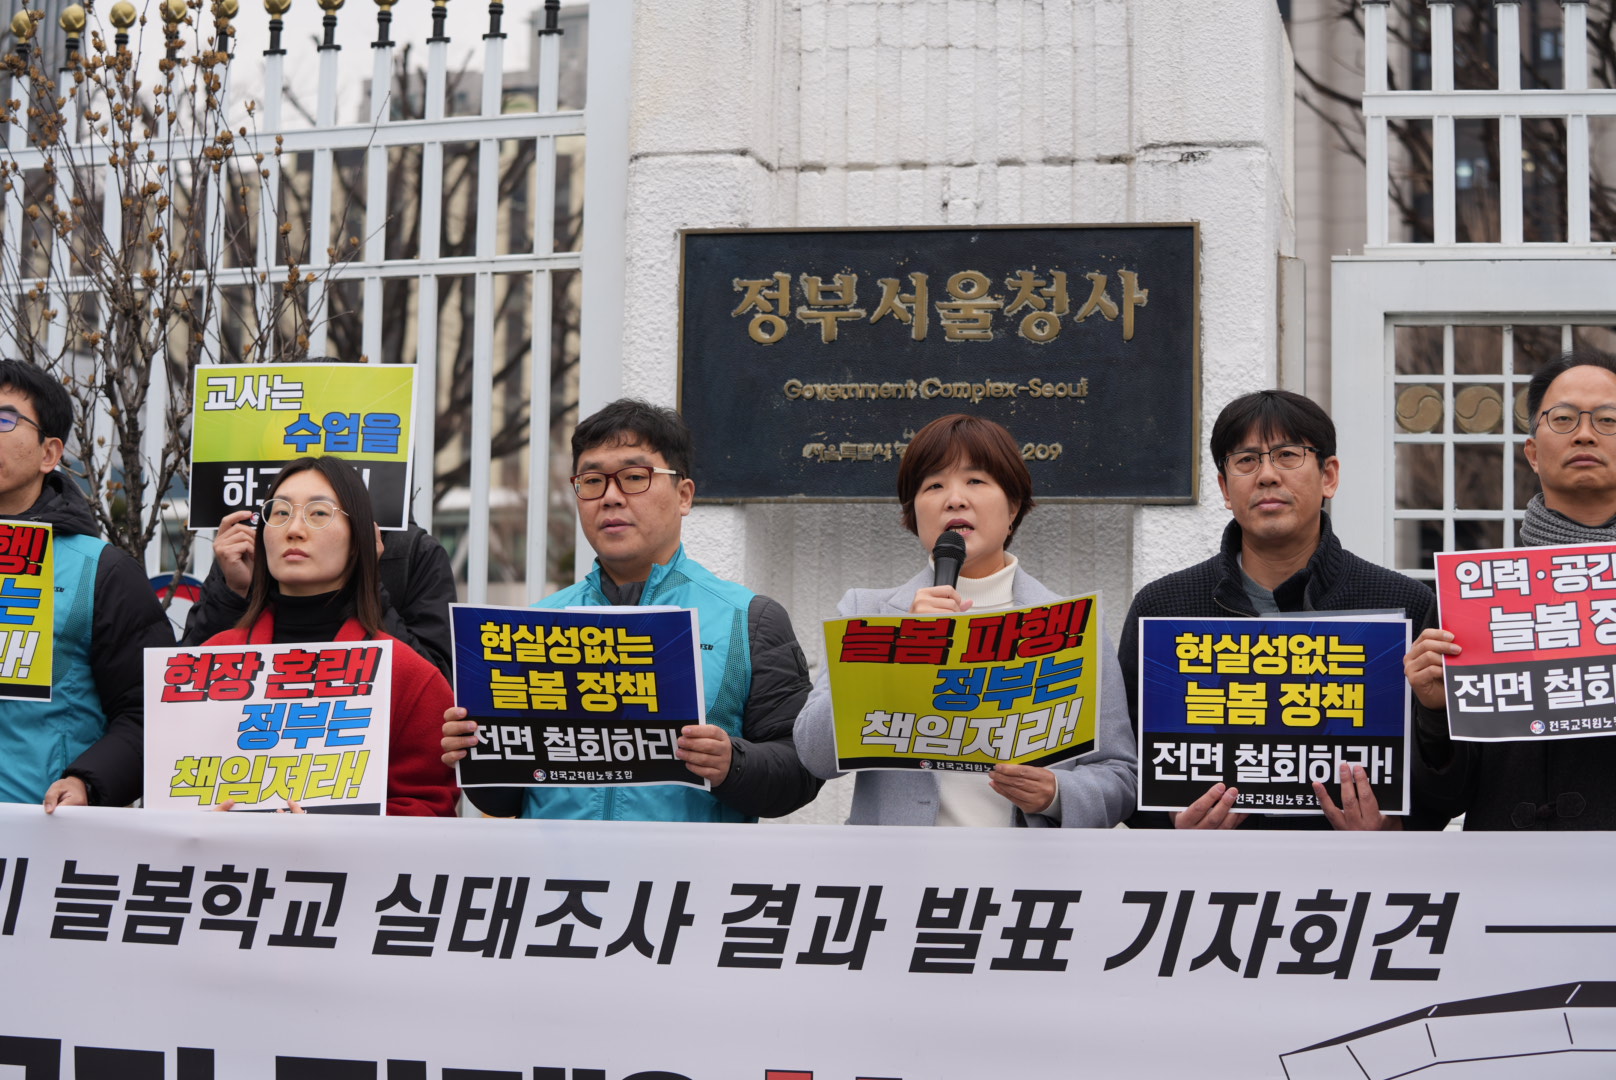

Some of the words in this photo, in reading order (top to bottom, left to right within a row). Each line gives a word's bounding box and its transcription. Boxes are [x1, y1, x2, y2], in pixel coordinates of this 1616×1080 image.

[731, 269, 1149, 346] 정부서울청사
[203, 374, 304, 412] 교사는
[784, 378, 916, 401] Government
[283, 412, 401, 454] 수업을
[1022, 443, 1063, 460] 209
[480, 621, 654, 665] 현실성없는
[839, 619, 956, 665] 늘봄
[960, 599, 1093, 663] 파행!
[1489, 601, 1581, 653] 늘봄
[161, 653, 263, 702] 현장
[264, 647, 382, 699] 혼란!
[1175, 632, 1366, 676] 현실성없는
[489, 668, 568, 710] 늘봄
[576, 671, 658, 713] 정책
[932, 656, 1084, 711] 정부는
[1184, 681, 1268, 726] 늘봄
[1278, 682, 1365, 728] 정책
[1453, 671, 1534, 713] 전면
[237, 701, 373, 750] 정부는
[470, 725, 536, 761] 전면
[861, 696, 1084, 761] 책임져라!
[1549, 716, 1616, 731] 전국교직원노
[169, 750, 370, 805] 책임져라!
[550, 770, 633, 780] 전국교직원노동조합
[936, 761, 993, 772] 전국교직원노
[1152, 743, 1224, 782] 전면
[1234, 744, 1393, 785] 철회하라!
[50, 859, 348, 950] 늘봄학교
[372, 873, 695, 965] 실태조사
[717, 882, 887, 971] 결과
[908, 886, 1082, 974] 발표
[1103, 888, 1460, 981] 기자회견
